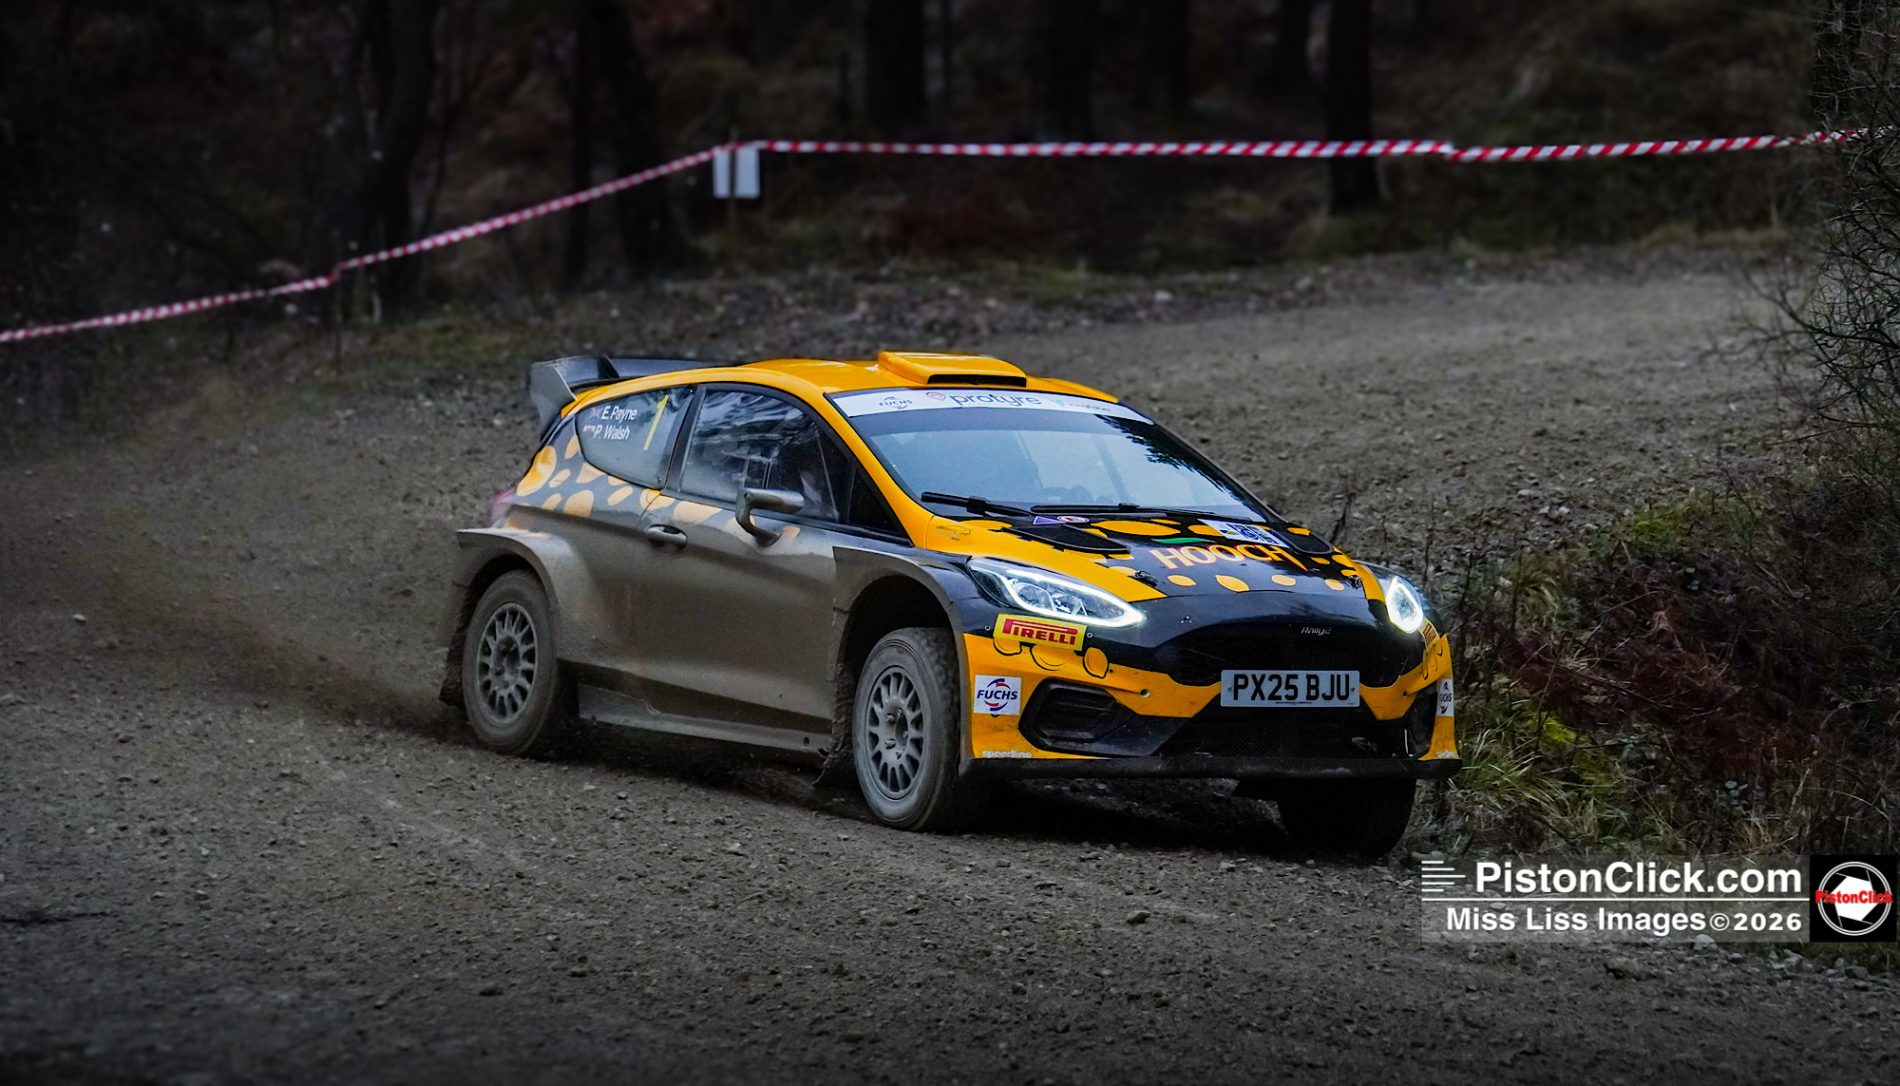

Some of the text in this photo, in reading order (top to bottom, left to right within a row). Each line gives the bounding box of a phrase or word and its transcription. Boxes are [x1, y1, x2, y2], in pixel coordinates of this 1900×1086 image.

[949, 393, 1042, 407] protyre
[610, 405, 638, 423] Payne
[642, 394, 669, 451] 1
[604, 425, 631, 440] Walsh
[1149, 544, 1309, 573] HOOCH
[1002, 618, 1079, 645] PIRELLI
[976, 689, 1018, 701] FUCHS
[1233, 674, 1350, 701] PX25 BJU
